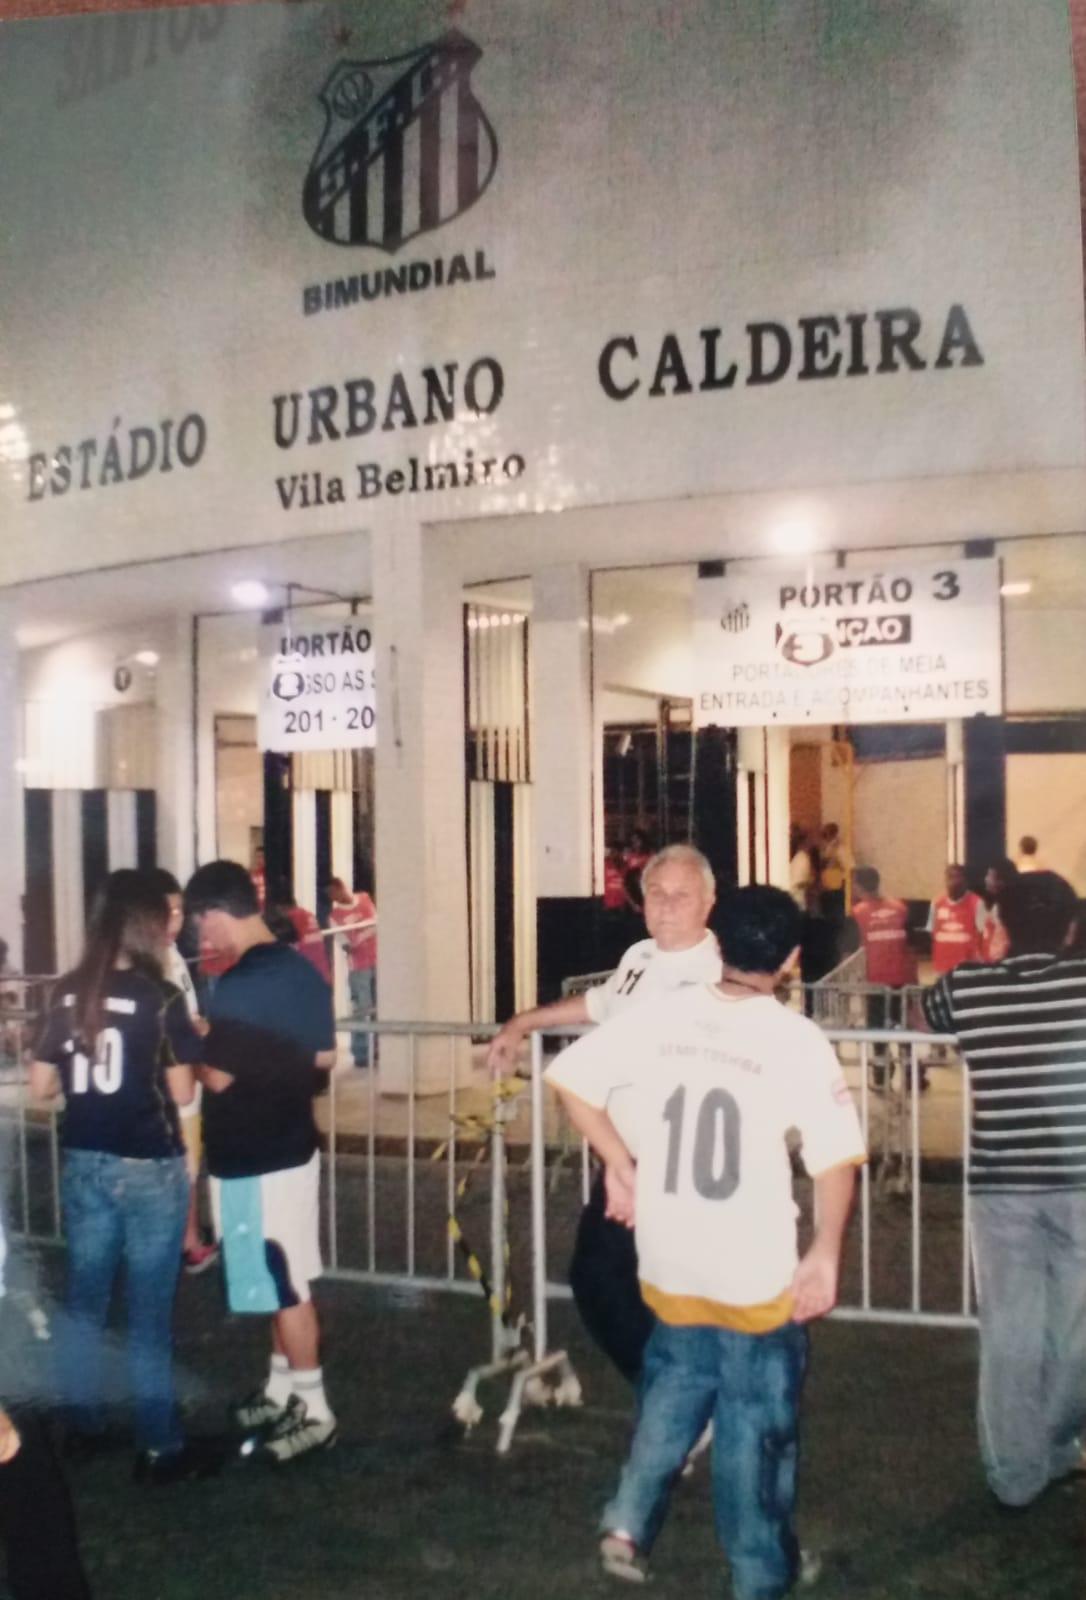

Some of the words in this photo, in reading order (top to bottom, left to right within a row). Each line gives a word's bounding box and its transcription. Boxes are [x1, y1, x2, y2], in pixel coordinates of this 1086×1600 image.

[302, 250, 496, 316] BIMUNDIAL
[27, 413, 208, 501] ESTÁDIO
[273, 356, 505, 449] URBANO
[598, 304, 984, 400] CALDEIRA
[276, 473, 345, 510] Vila
[356, 449, 526, 499] Belmiro
[779, 574, 912, 610] PORTÃO
[932, 570, 961, 600] 3
[281, 625, 371, 657] PORTÃO
[342, 670, 365, 691] AS
[900, 653, 948, 673] MEIA
[700, 689, 787, 711] ENTRADA
[285, 709, 323, 734] 201
[661, 1082, 743, 1201] 10
